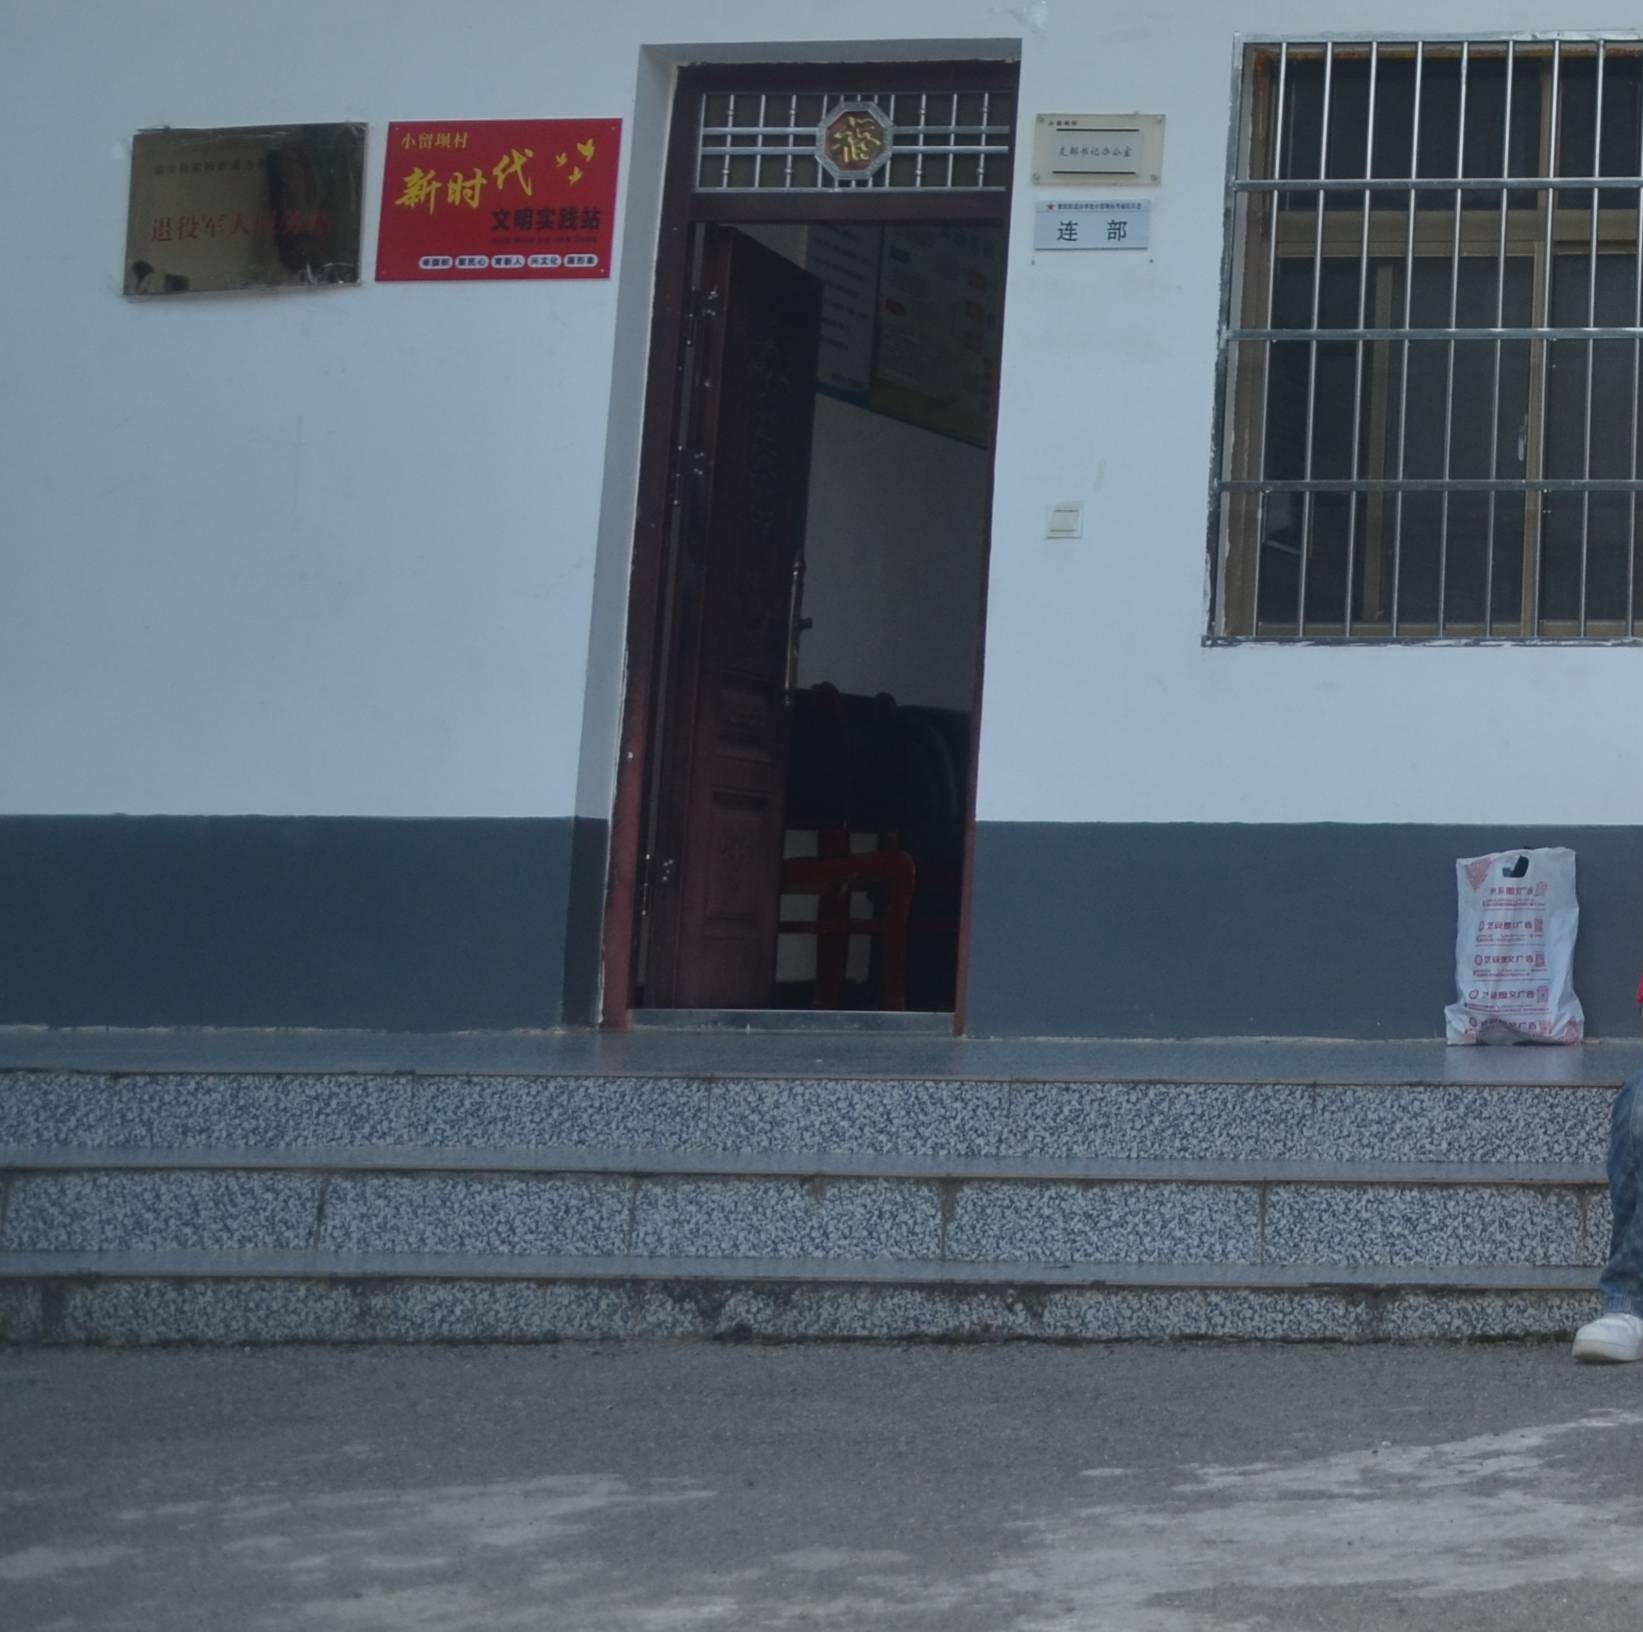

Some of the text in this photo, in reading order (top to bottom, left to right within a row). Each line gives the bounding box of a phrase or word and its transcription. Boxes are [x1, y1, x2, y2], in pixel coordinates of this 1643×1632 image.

[401, 131, 470, 150] 小留坝村
[394, 147, 535, 215] 新时代
[490, 207, 601, 232] 文明实践站
